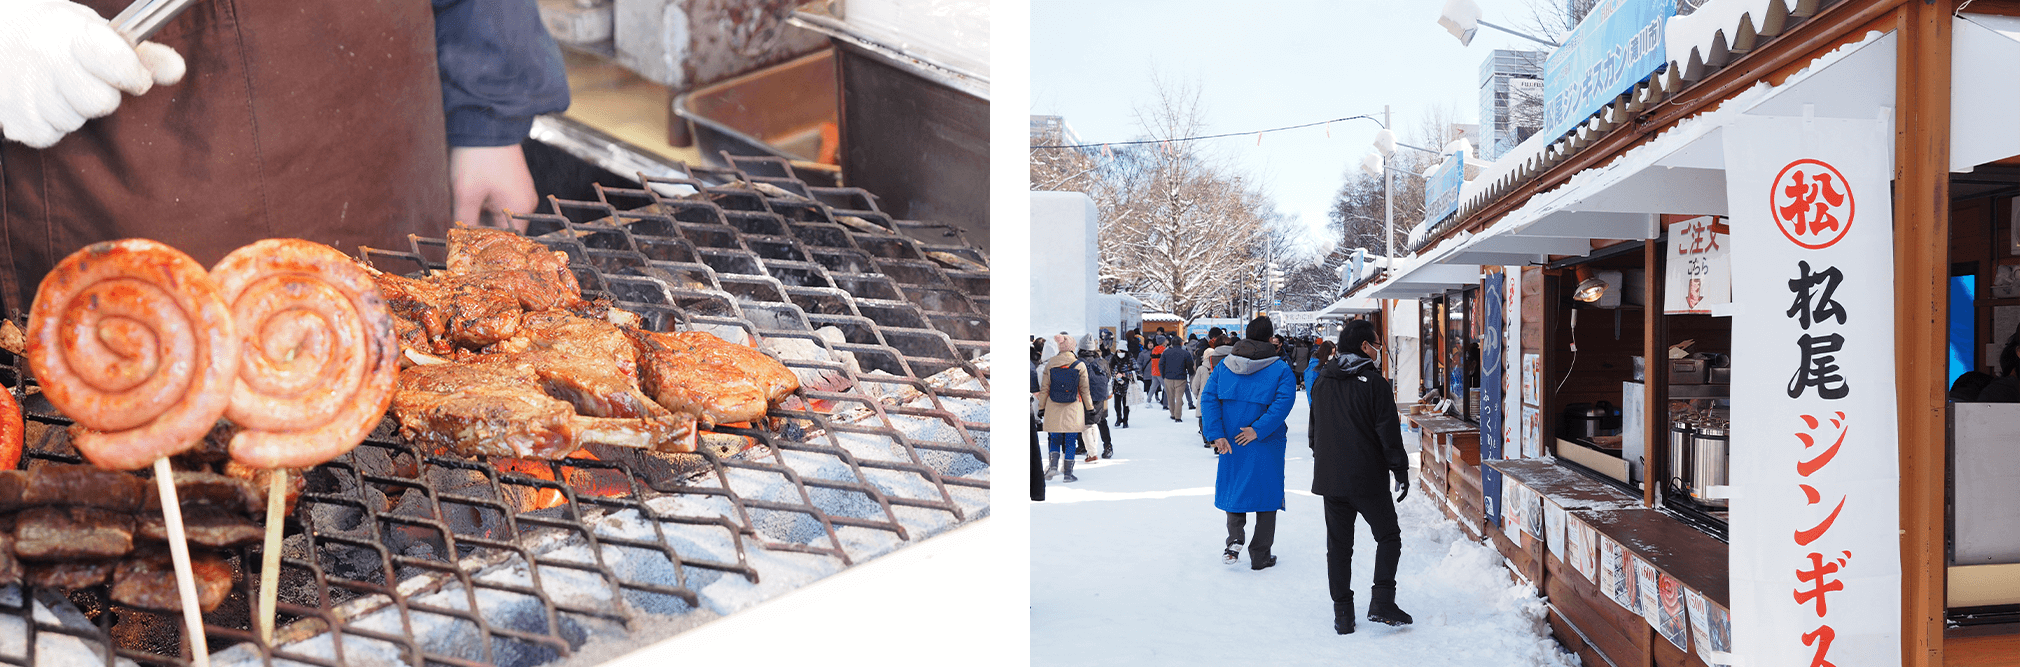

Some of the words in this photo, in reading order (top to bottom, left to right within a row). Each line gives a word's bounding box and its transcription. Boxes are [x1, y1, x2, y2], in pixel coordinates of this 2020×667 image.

[1780, 170, 1846, 237] 松
[1678, 221, 1720, 256] ご注文
[1687, 257, 1709, 276] こちら
[1786, 260, 1852, 667] 松尾ジンギス
